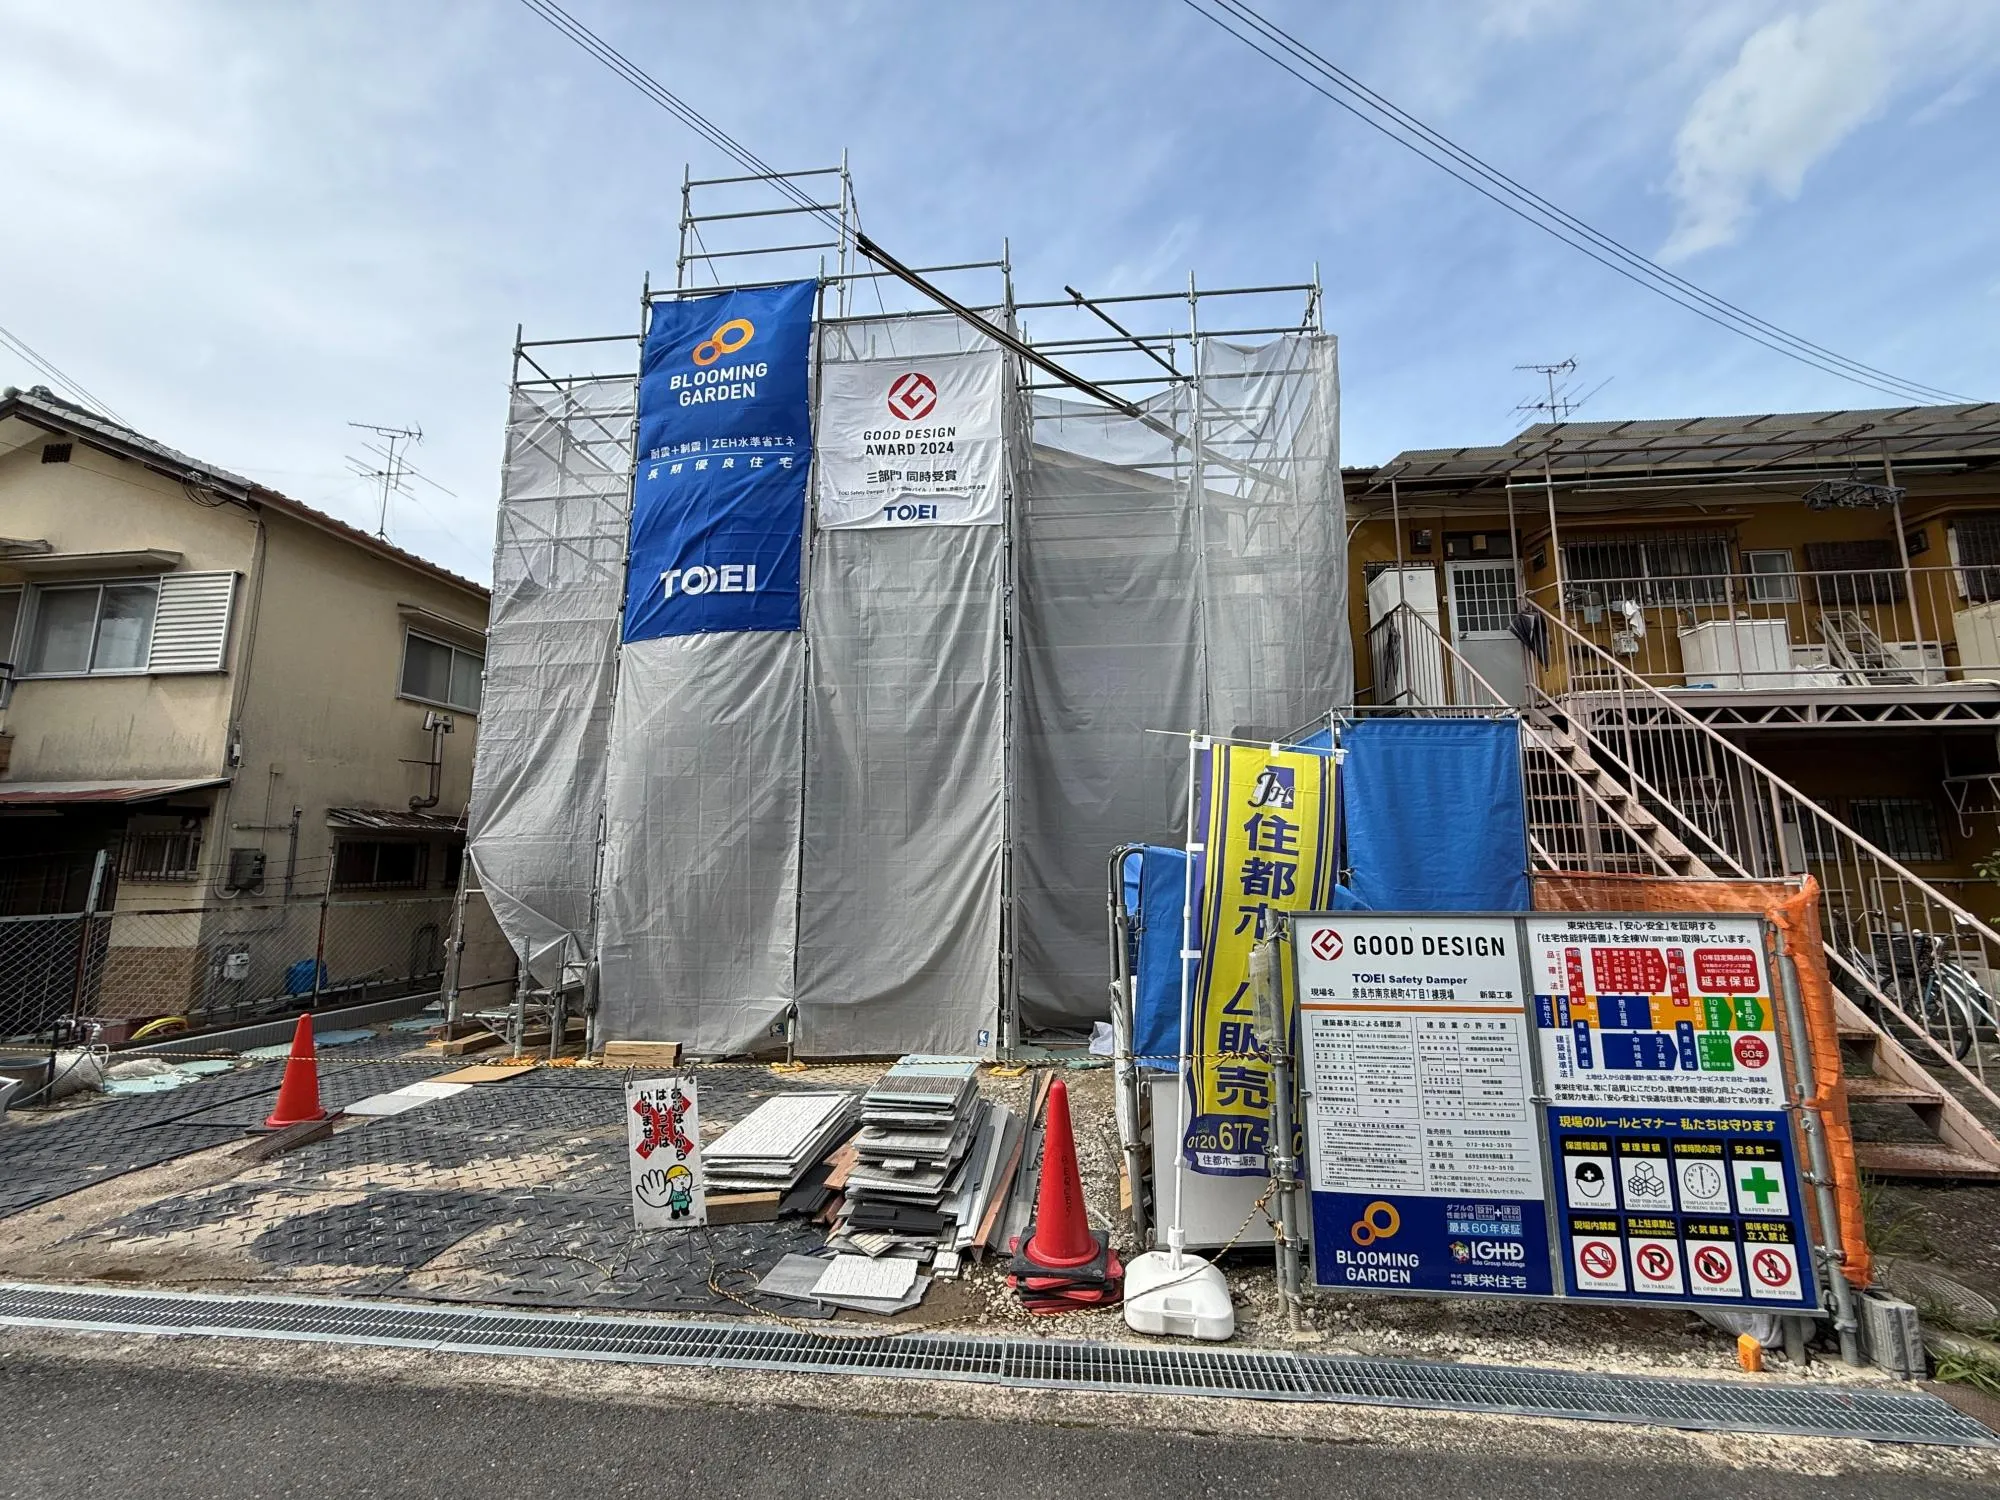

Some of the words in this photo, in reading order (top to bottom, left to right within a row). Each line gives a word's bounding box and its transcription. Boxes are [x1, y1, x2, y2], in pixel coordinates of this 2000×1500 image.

[670, 363, 768, 390] BLOOMING
[679, 382, 756, 407] GARDEN
[864, 430, 901, 441] GOOD
[906, 427, 956, 439] DESIGN
[712, 436, 796, 449] ZEH水準省エネ
[866, 444, 915, 456] AWARD
[920, 442, 955, 455] 2024
[648, 456, 793, 480] 長期優良住宅
[866, 470, 902, 484] 三部門
[906, 470, 957, 483] 同時受賞
[884, 505, 937, 521] TOEI
[660, 565, 756, 599] TOEI
[1354, 936, 1414, 956] GOOD
[1422, 936, 1506, 957] DESIGN
[1352, 974, 1385, 984] TOEI
[1389, 975, 1423, 985] Safety
[1426, 976, 1467, 985] Damper
[1701, 976, 1755, 987] 延長保証
[1311, 988, 1335, 997] 現場名
[1480, 991, 1512, 999] 新築工事
[1542, 998, 1552, 1026] 土地仕入
[1618, 999, 1629, 1027] 施工管理
[1709, 1000, 1719, 1028] 10年保証
[1632, 1037, 1643, 1068] 中間検査
[1656, 1037, 1666, 1068] 完了検査
[1681, 1023, 1693, 1068] 検査済証
[1700, 1038, 1711, 1068] 定期点検
[1556, 1035, 1568, 1078] 建築基準法
[1741, 1050, 1764, 1059] 60年
[640, 1091, 655, 1151] いけません
[656, 1089, 670, 1148] はいっては
[671, 1088, 686, 1161] あぶないから
[1559, 1116, 1677, 1129] 現場のルールとマナー
[1681, 1117, 1776, 1132] 私たちは守ります
[1187, 1135, 1217, 1149] 0120
[1621, 1142, 1661, 1152] 整理整頓
[1735, 1145, 1776, 1155] 安全第一
[1449, 1222, 1521, 1235] 最長60年保証
[1574, 1221, 1617, 1231] 現場内禁煙
[1628, 1219, 1675, 1229] 路上駐車禁止
[1688, 1224, 1729, 1235] 火気厳禁
[1745, 1222, 1786, 1232] 関係者以外
[1747, 1232, 1789, 1242] 立入禁止
[1336, 1250, 1419, 1268] BLOOMING
[1346, 1268, 1411, 1283] GARDEN
[1463, 1274, 1527, 1289] 東栄住宅
